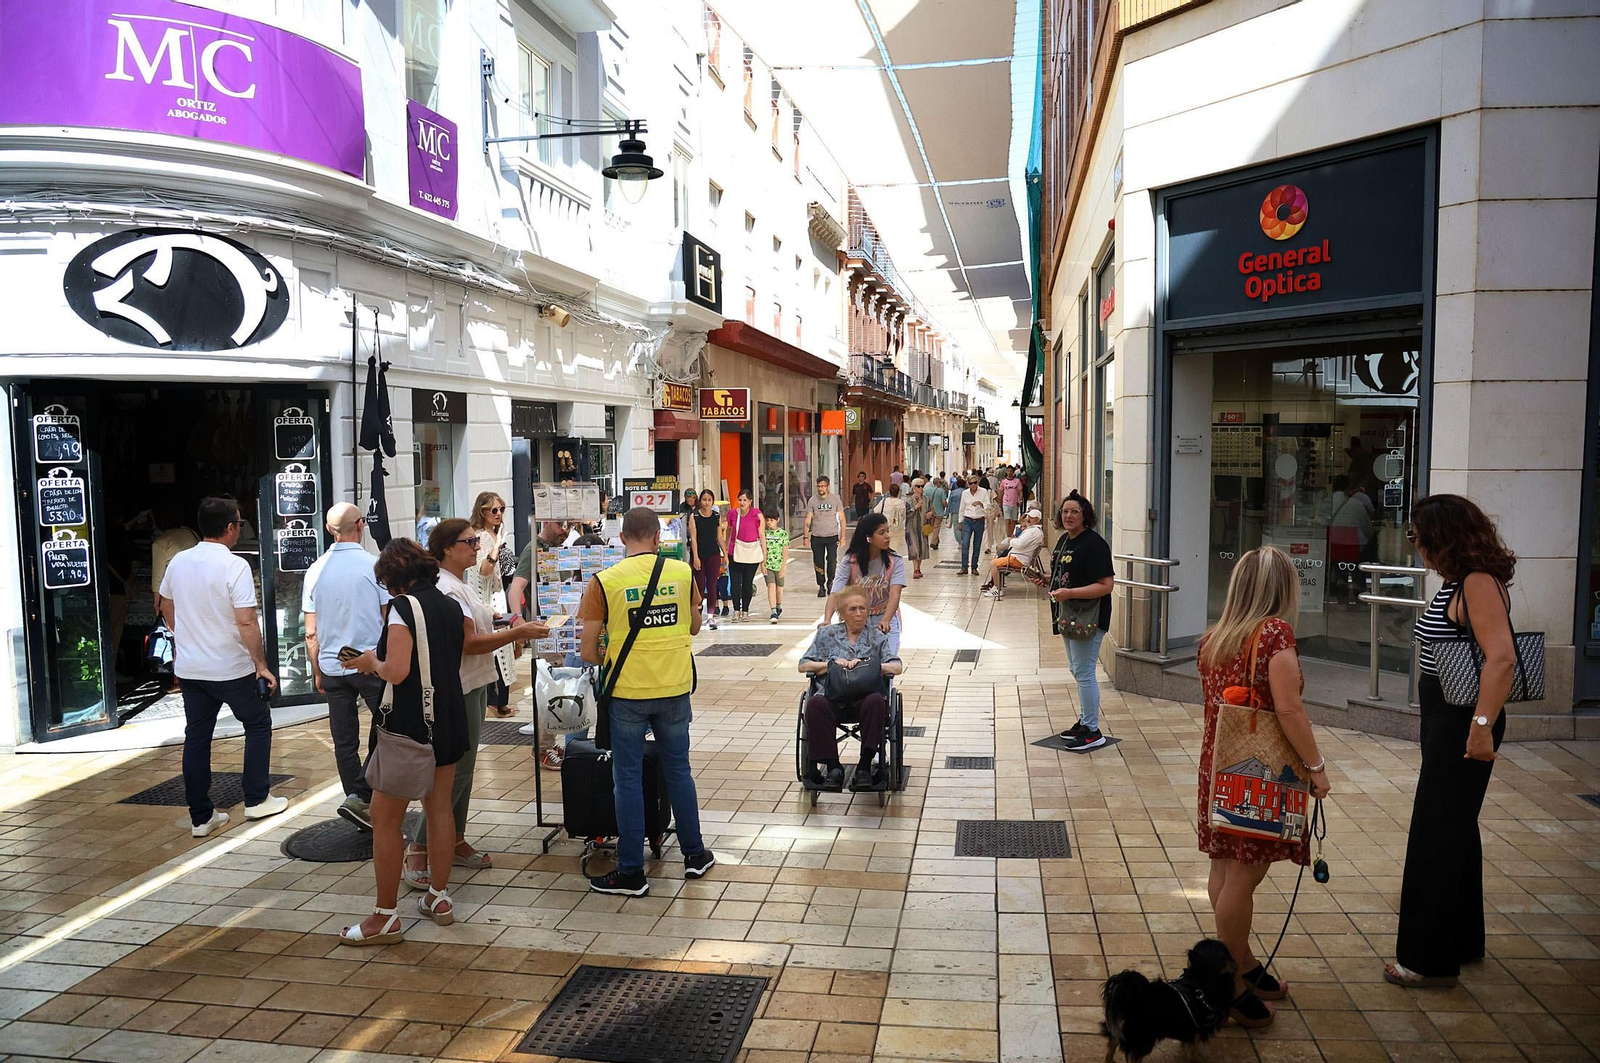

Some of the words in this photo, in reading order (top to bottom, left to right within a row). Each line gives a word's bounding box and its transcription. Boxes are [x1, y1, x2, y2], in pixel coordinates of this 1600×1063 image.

[105, 19, 256, 99] MC
[176, 97, 217, 112] ORTIZ
[167, 109, 227, 125] ABOGADOS
[417, 120, 450, 161] MC
[1238, 239, 1331, 274] General
[1244, 270, 1321, 302] Optica
[670, 385, 692, 403] TABACOS
[702, 407, 745, 416] TABACOS
[37, 416, 78, 424] OFERTA
[276, 417, 312, 425] OFERTA
[278, 473, 314, 481] OFERTA
[40, 479, 81, 487] OFERTA
[280, 529, 316, 537] OFERTA
[44, 540, 86, 549] OFERTA
[661, 606, 676, 614] social
[643, 613, 676, 626] ONCE
